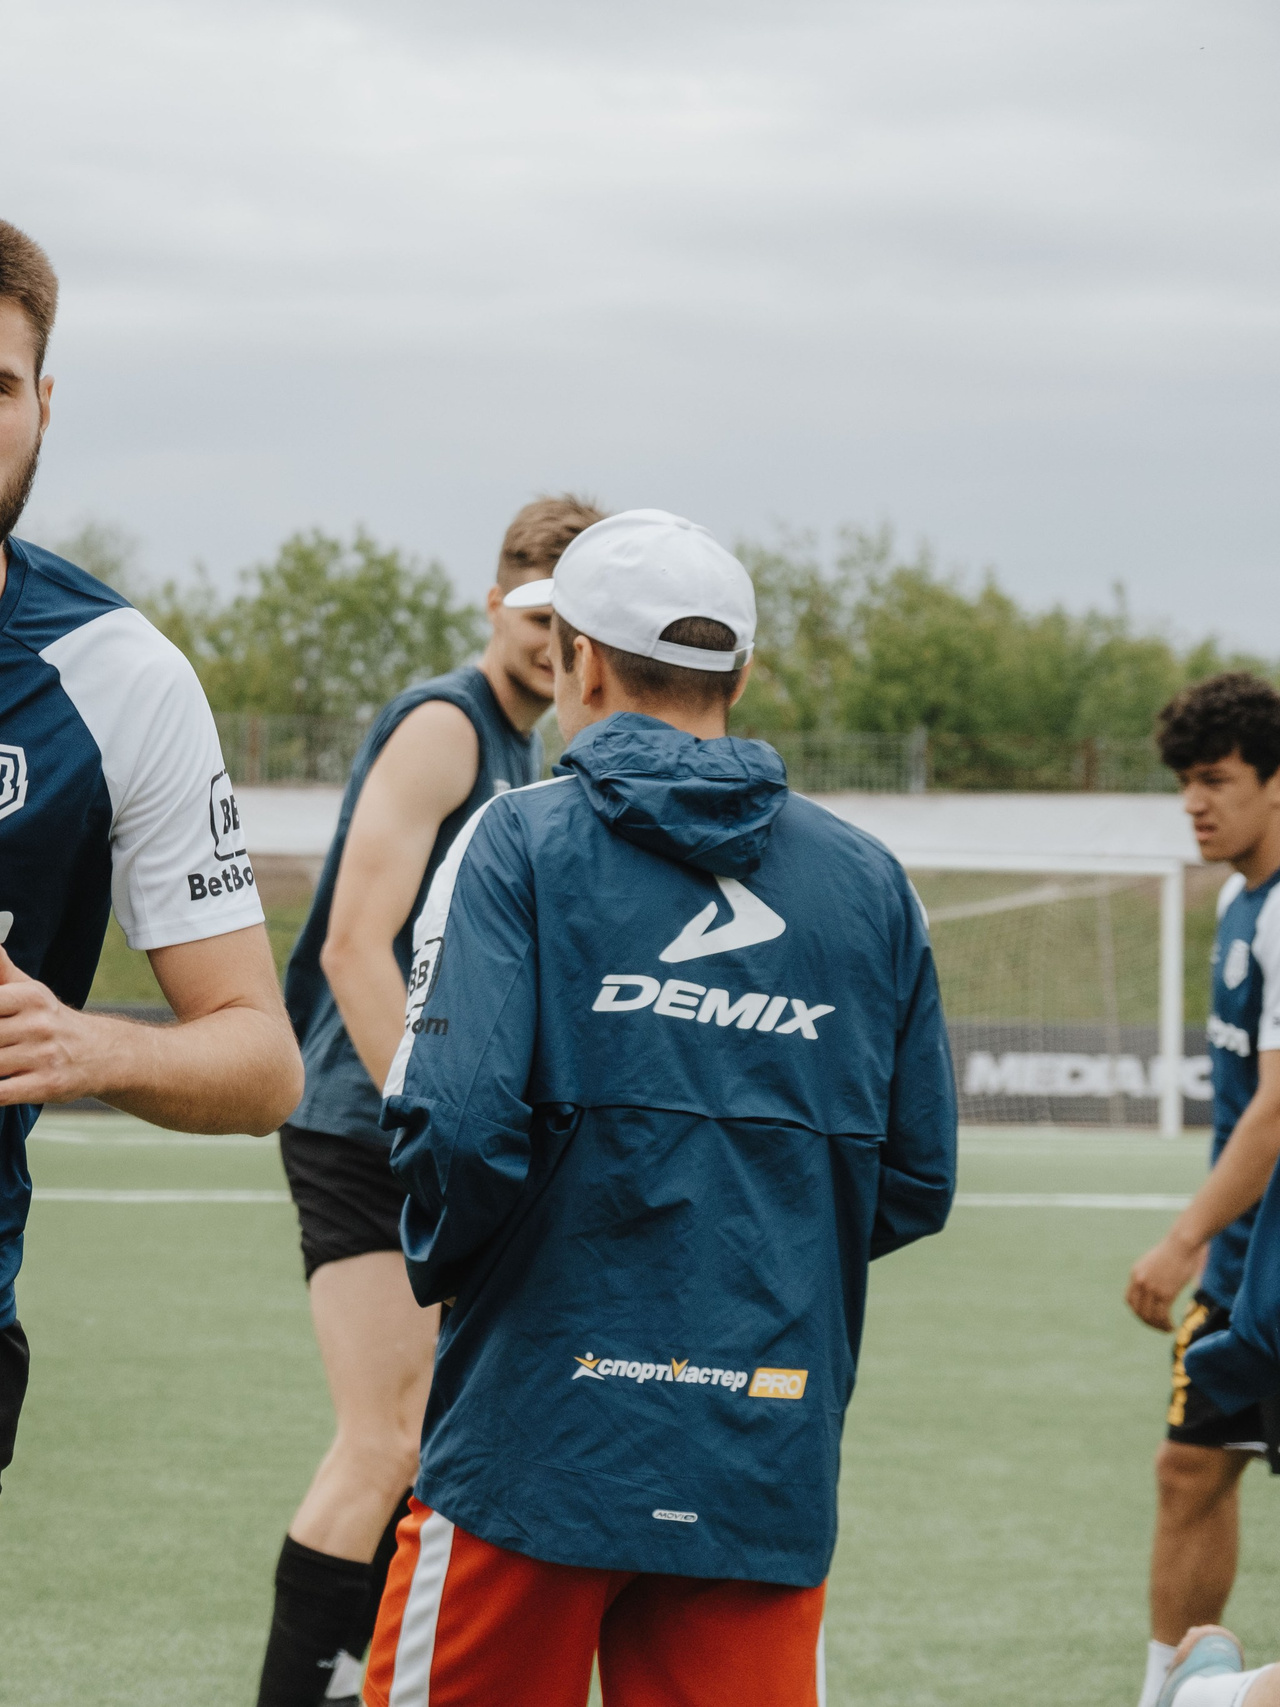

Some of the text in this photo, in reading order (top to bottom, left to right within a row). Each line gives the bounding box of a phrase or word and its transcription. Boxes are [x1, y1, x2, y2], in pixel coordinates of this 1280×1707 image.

[187, 864, 254, 901] BetBo
[591, 973, 837, 1041] DEMIX
[752, 1372, 803, 1396] PRO
